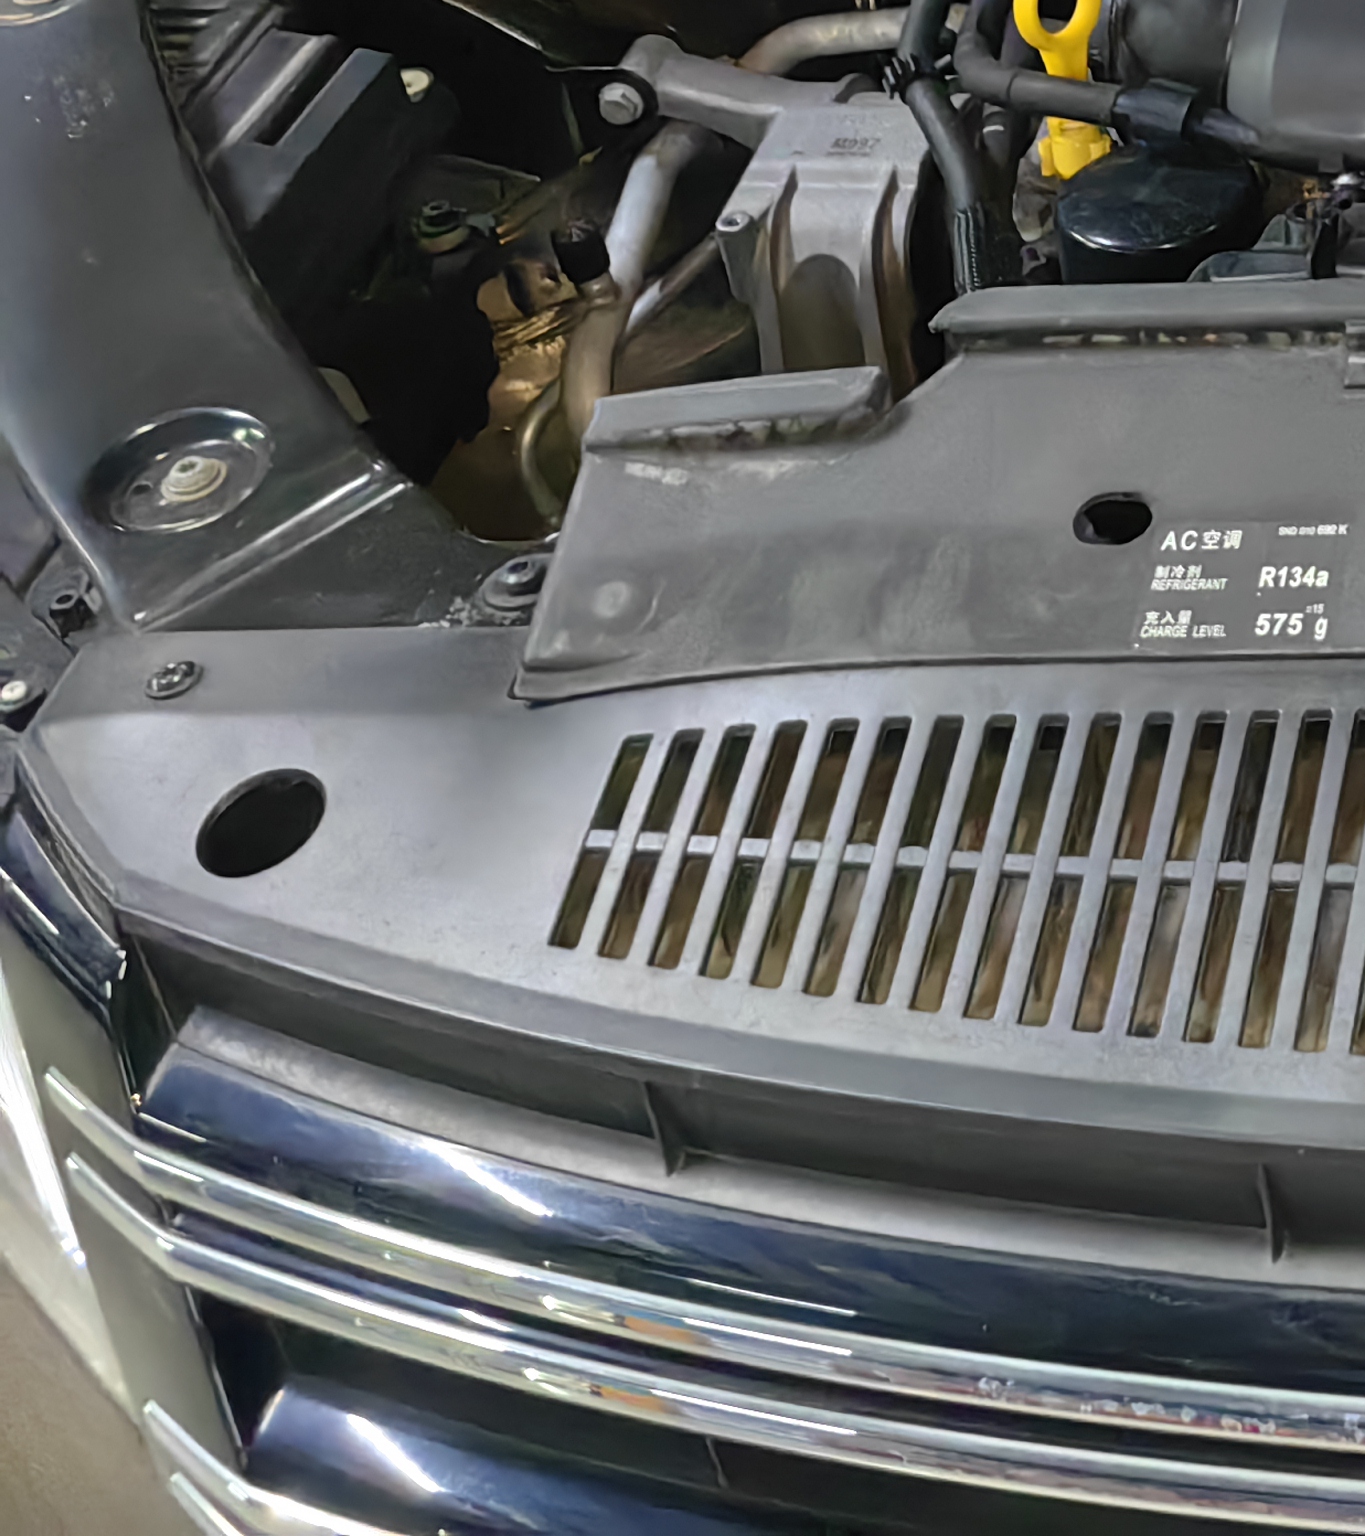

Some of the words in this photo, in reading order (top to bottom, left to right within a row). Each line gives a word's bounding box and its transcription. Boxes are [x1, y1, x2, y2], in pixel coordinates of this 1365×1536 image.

[1338, 524, 1349, 535] K
[1258, 566, 1329, 588] R134a
[1151, 578, 1228, 591] REFRIGERANT
[1140, 625, 1188, 638] CHARGE
[1192, 624, 1227, 638] LEVEL
[1254, 613, 1303, 637] 575
[1314, 616, 1328, 641] g
